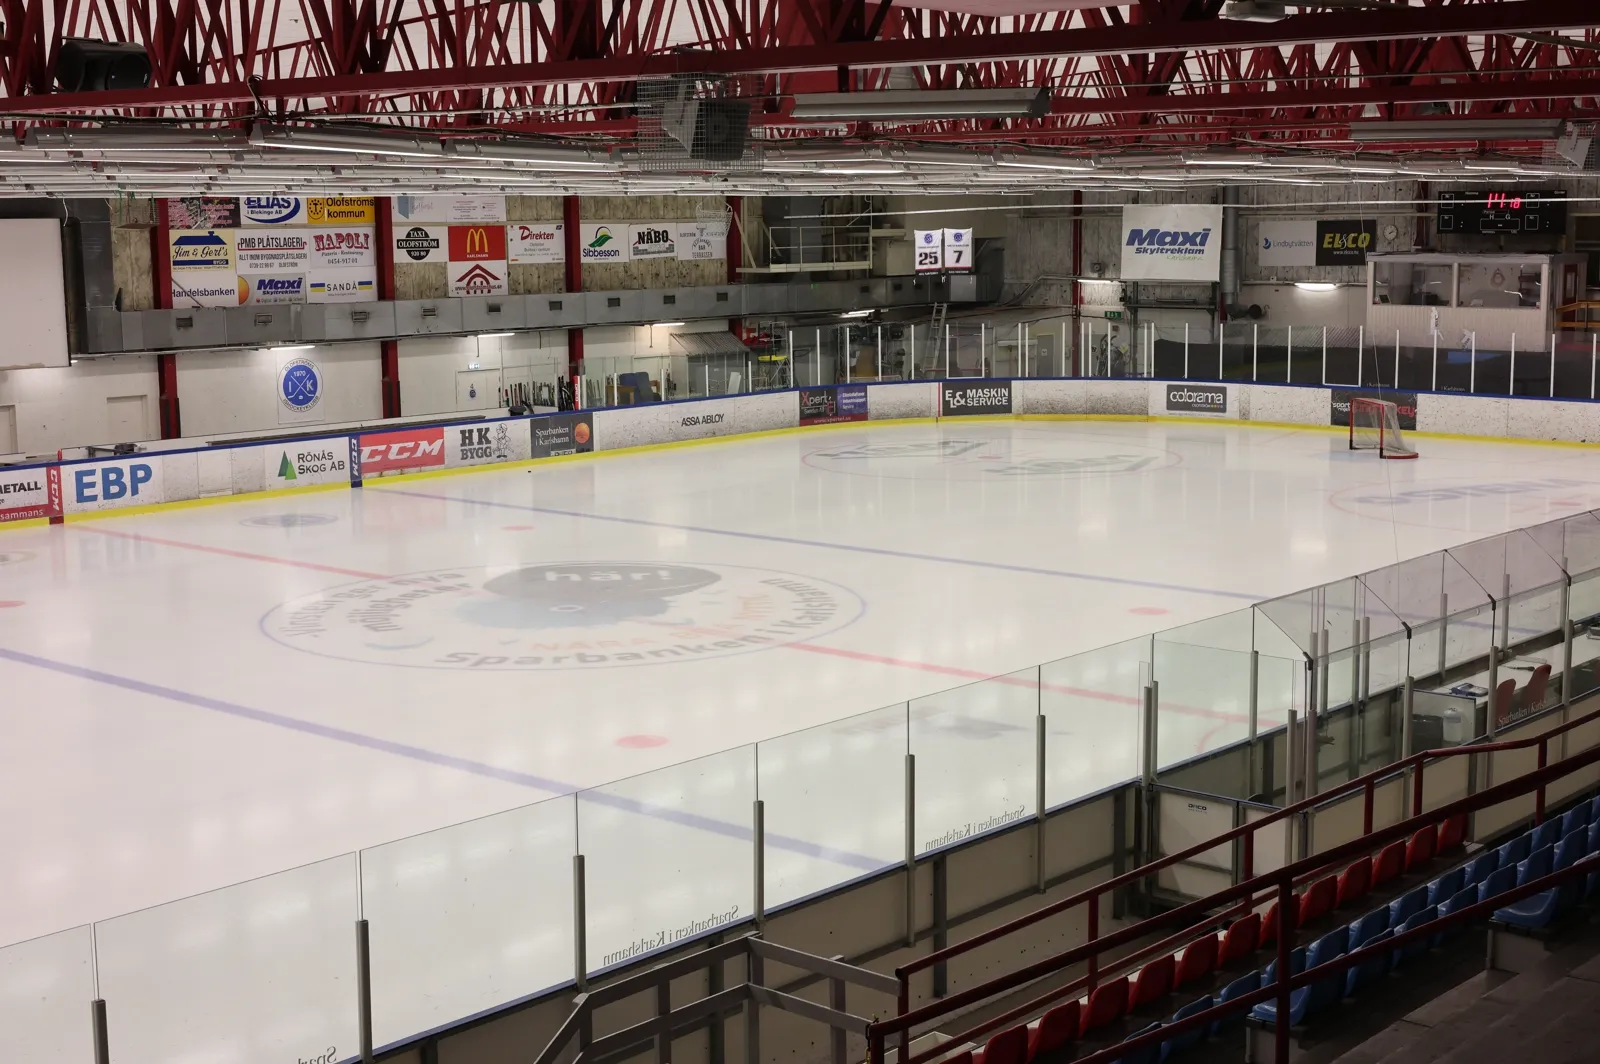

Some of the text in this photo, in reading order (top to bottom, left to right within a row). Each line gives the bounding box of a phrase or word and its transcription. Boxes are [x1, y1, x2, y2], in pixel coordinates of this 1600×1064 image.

[246, 197, 292, 209] ELIAS
[326, 197, 375, 207] Olofströms
[327, 209, 365, 218] kommun
[519, 225, 555, 241] Direkten
[637, 227, 669, 245] NÄBO
[1126, 228, 1212, 247] Maxi
[240, 234, 303, 248] PMB PLÅTSLAGERI
[313, 232, 370, 251] NAPOLI
[398, 239, 438, 247] OLOFSTRÖM
[172, 246, 190, 259] Jim
[192, 248, 199, 257] &
[582, 247, 620, 257] Sibbesson
[953, 250, 963, 264] 7
[1135, 246, 1205, 255] Skyltreklam
[918, 251, 939, 266] 25
[257, 277, 303, 290] Maxi
[966, 388, 1009, 399] MASKIN
[1170, 388, 1223, 404] colorama
[966, 396, 1009, 407] SERVICE
[681, 413, 725, 427] ASSA ABLOY
[535, 426, 569, 438] Sparbanken
[539, 435, 570, 446] Karlshamn
[297, 450, 334, 464] RÖNÅS
[351, 438, 359, 477] CCM
[358, 438, 444, 464] CCM
[460, 446, 493, 460] BYGG
[298, 460, 345, 475] SKOG AB
[50, 468, 60, 511] CCM
[75, 463, 153, 504] EBP
[544, 569, 674, 582] här!
[434, 634, 775, 668] Sparbanken
[757, 577, 839, 629] Karlshamn
